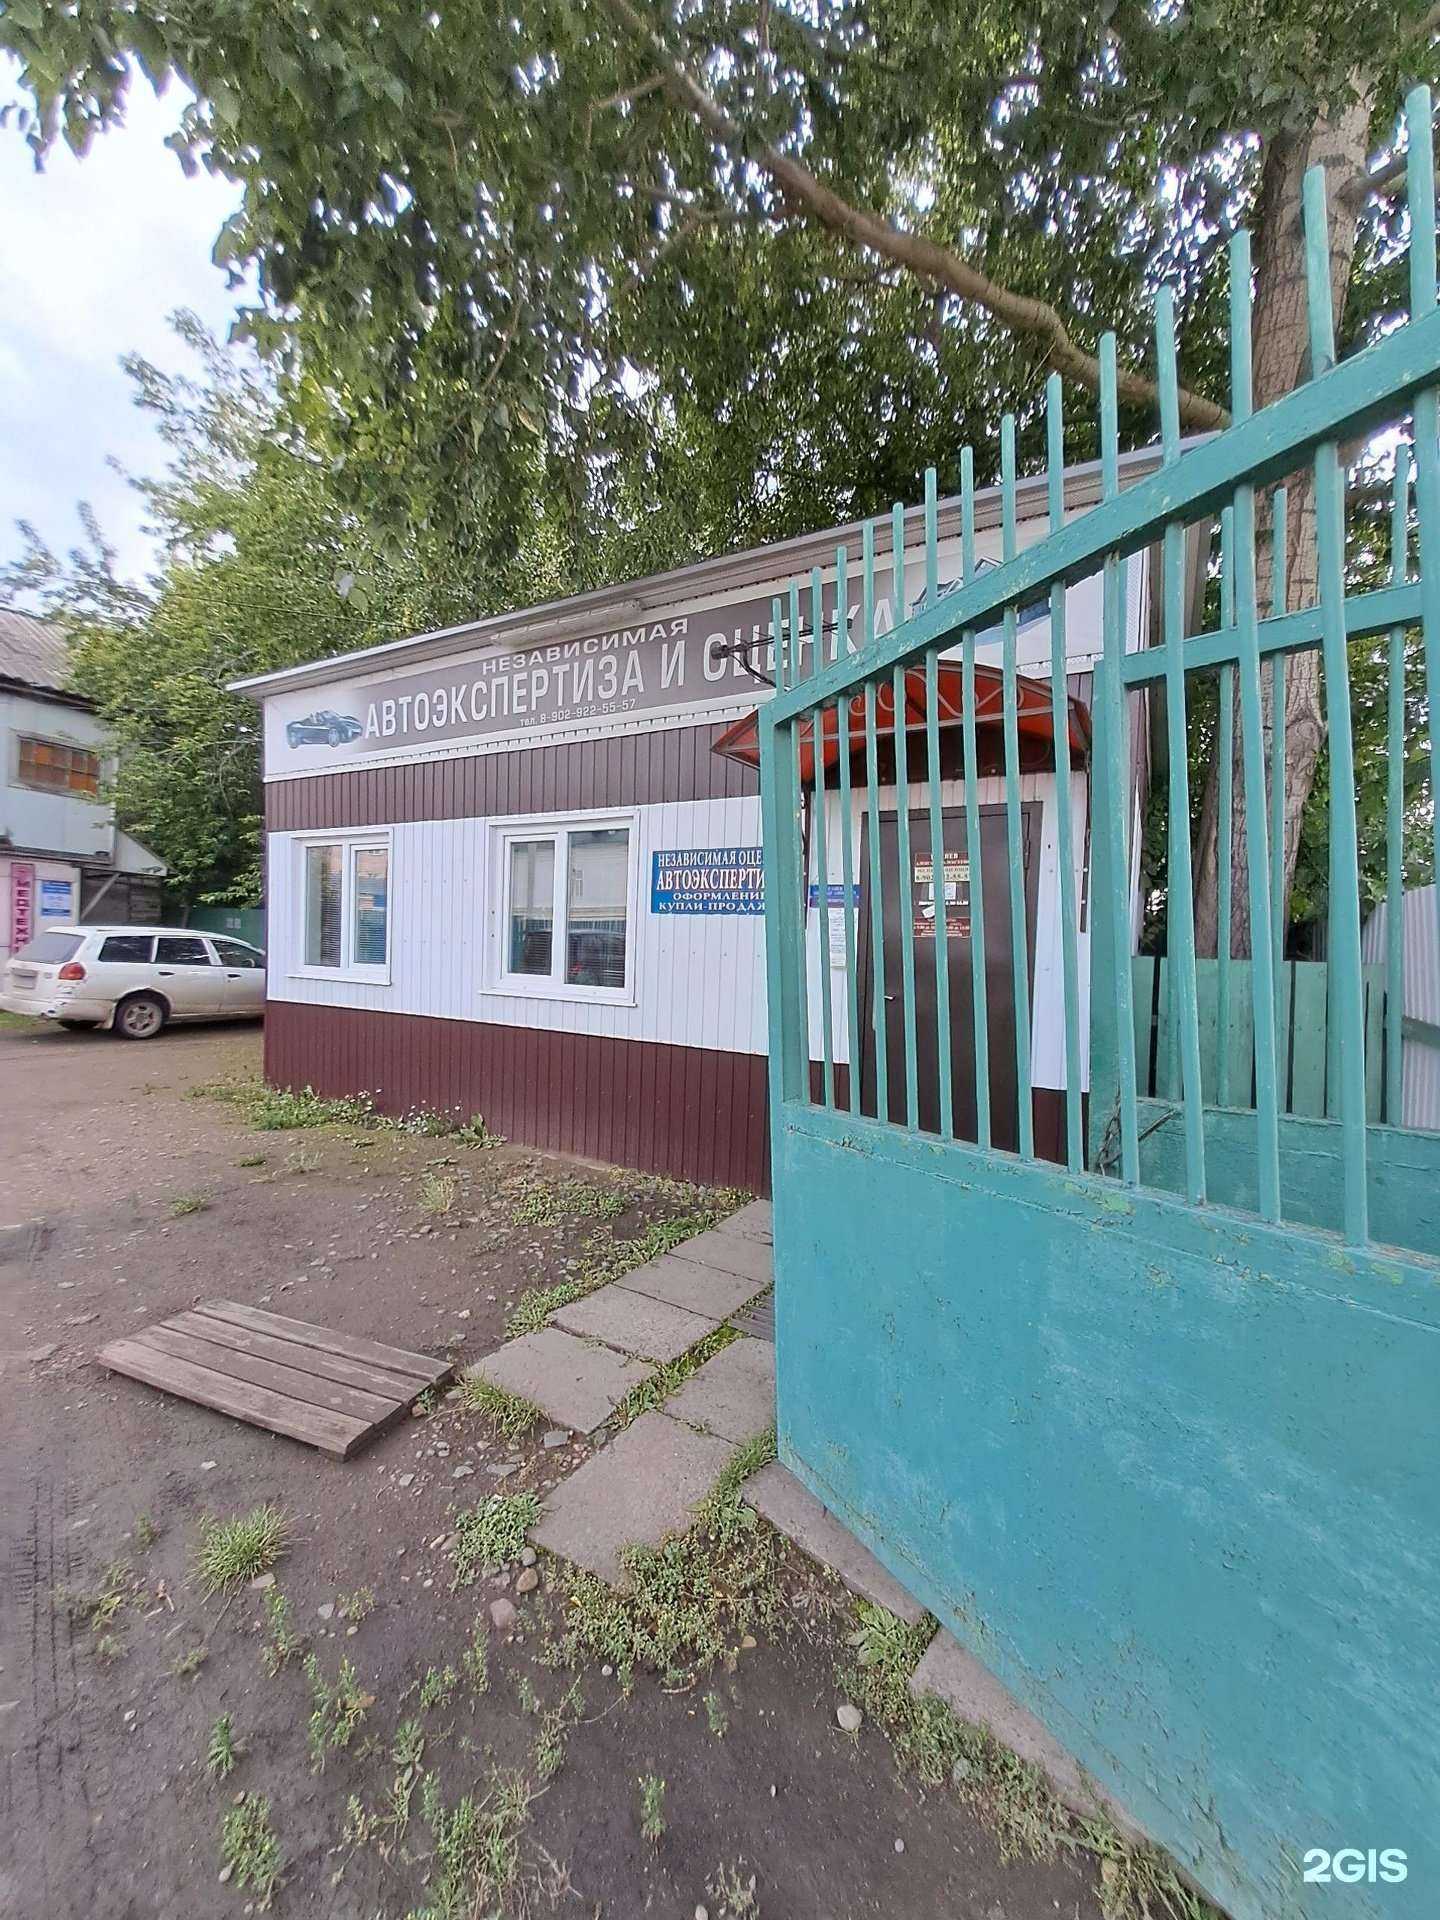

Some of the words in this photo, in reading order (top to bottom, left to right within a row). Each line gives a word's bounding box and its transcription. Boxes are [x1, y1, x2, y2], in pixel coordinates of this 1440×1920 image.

[482, 618, 689, 675] НЕЗАВИСИМАЯ
[363, 648, 645, 740] АВТОЭКСПЕРТИЗА
[660, 640, 687, 690] И
[658, 850, 737, 868] НЕЗАВИСИМАЯ
